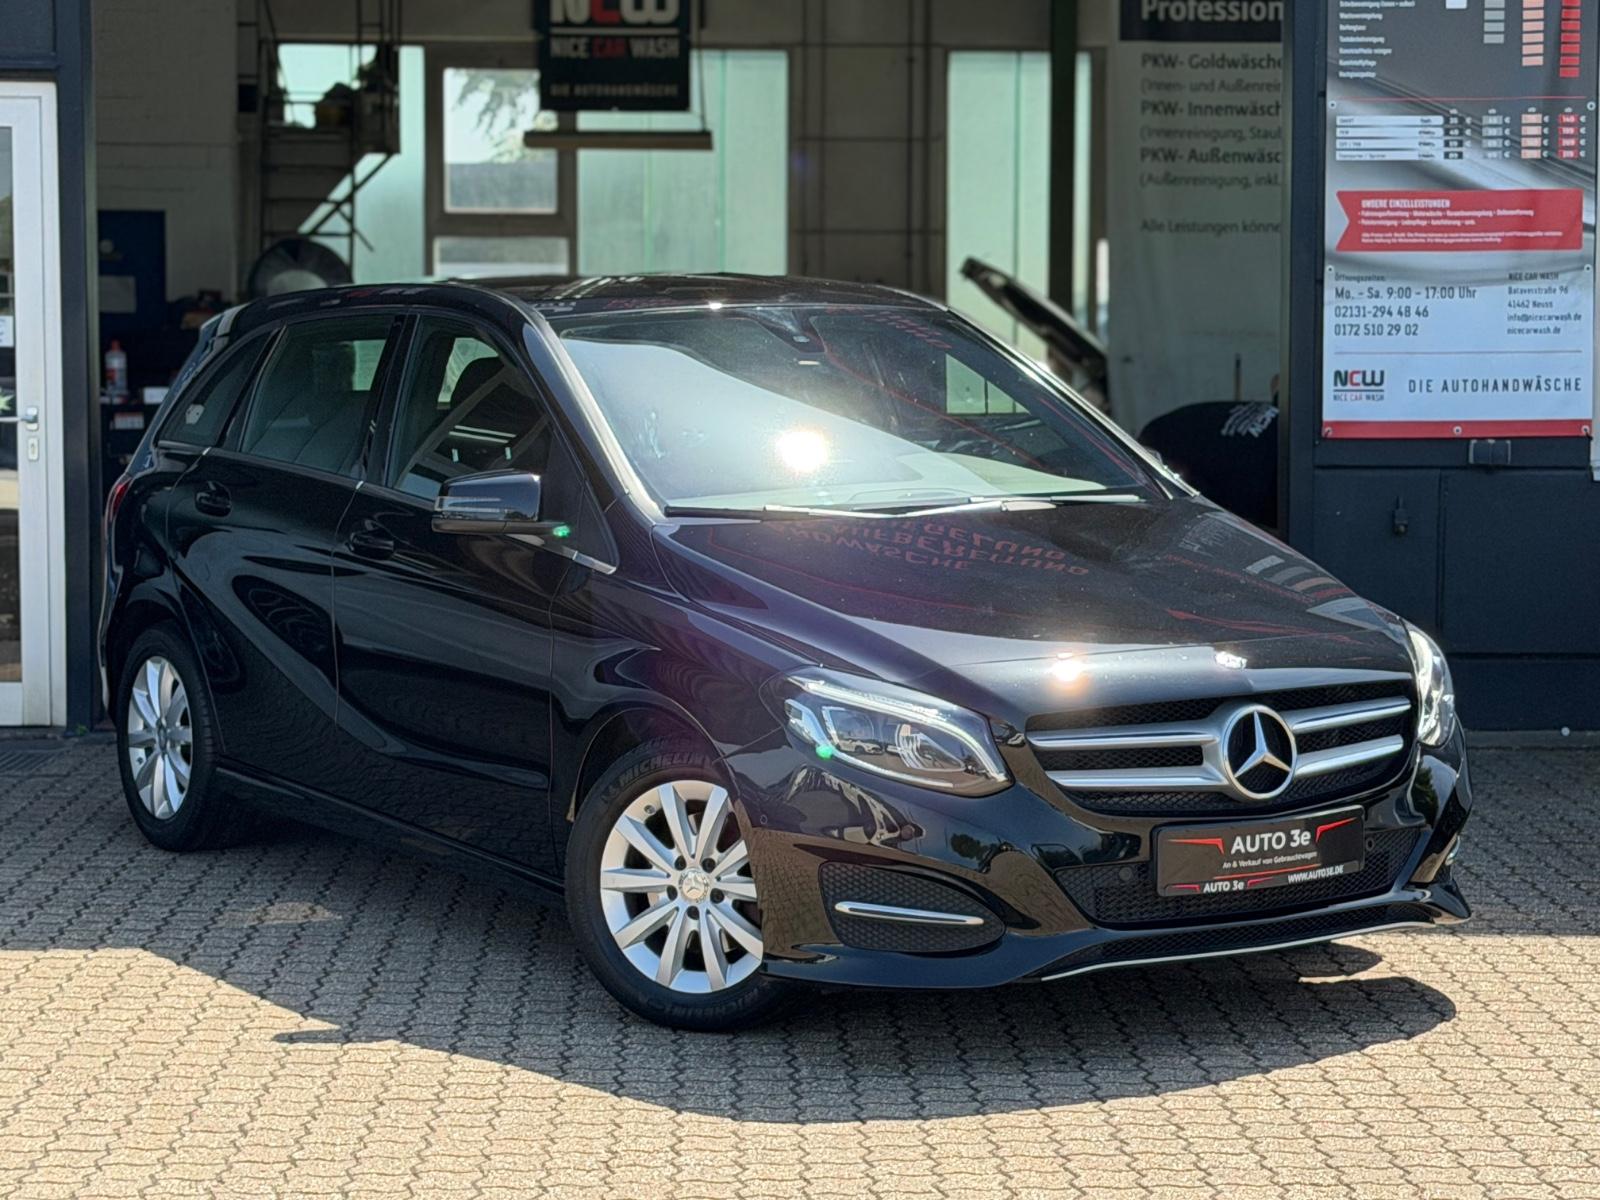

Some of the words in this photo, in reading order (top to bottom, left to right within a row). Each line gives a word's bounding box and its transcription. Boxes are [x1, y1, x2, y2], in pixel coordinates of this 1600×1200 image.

[551, 37, 589, 58] NICE
[592, 38, 626, 57] CAR
[630, 37, 679, 58] WASH
[1190, 79, 1214, 92] und
[1141, 219, 1164, 233] Alle
[1168, 219, 1239, 236] Leistungen
[1367, 286, 1383, 299] Sa.
[1387, 286, 1412, 299] 9:00
[1425, 286, 1455, 299] 17:00
[1459, 286, 1477, 299] Uhr
[1334, 305, 1393, 318] 02131-294
[1397, 305, 1411, 318] 48
[1415, 305, 1429, 318] 46
[1334, 323, 1360, 336] 0172
[1364, 323, 1384, 336] 510
[1387, 323, 1401, 336] 29
[1404, 323, 1419, 336] 02
[1333, 369, 1385, 387] NCW
[1408, 379, 1433, 393] DIE
[1441, 376, 1582, 393] AUTOHANDWÄSCHE
[1230, 831, 1286, 855] AUTO
[1290, 829, 1311, 848] 3e
[1223, 861, 1232, 869] An
[1239, 858, 1261, 868] Verkauf
[1263, 857, 1273, 865] von
[1203, 881, 1230, 893] AUTO
[1232, 879, 1244, 891] 3e
